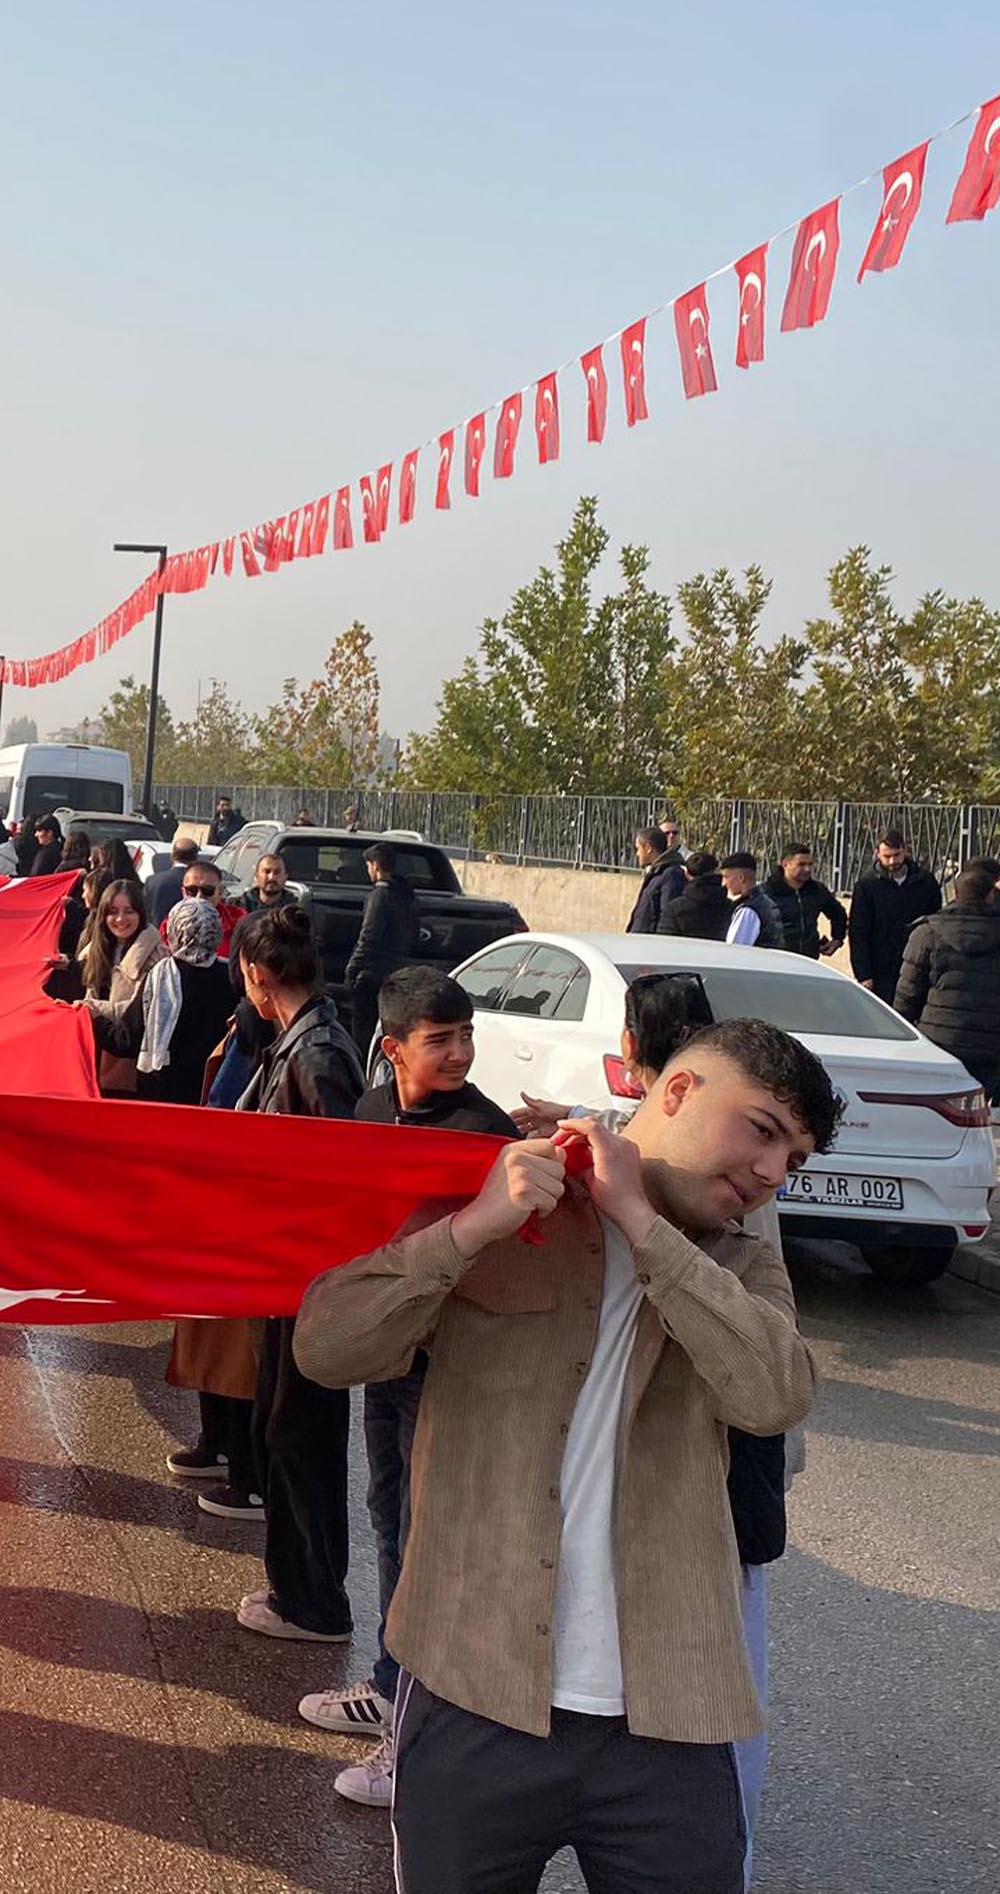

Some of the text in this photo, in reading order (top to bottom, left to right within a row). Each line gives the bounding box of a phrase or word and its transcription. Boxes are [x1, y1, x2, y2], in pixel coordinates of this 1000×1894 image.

[788, 1174, 897, 1201] 76 AR 002
